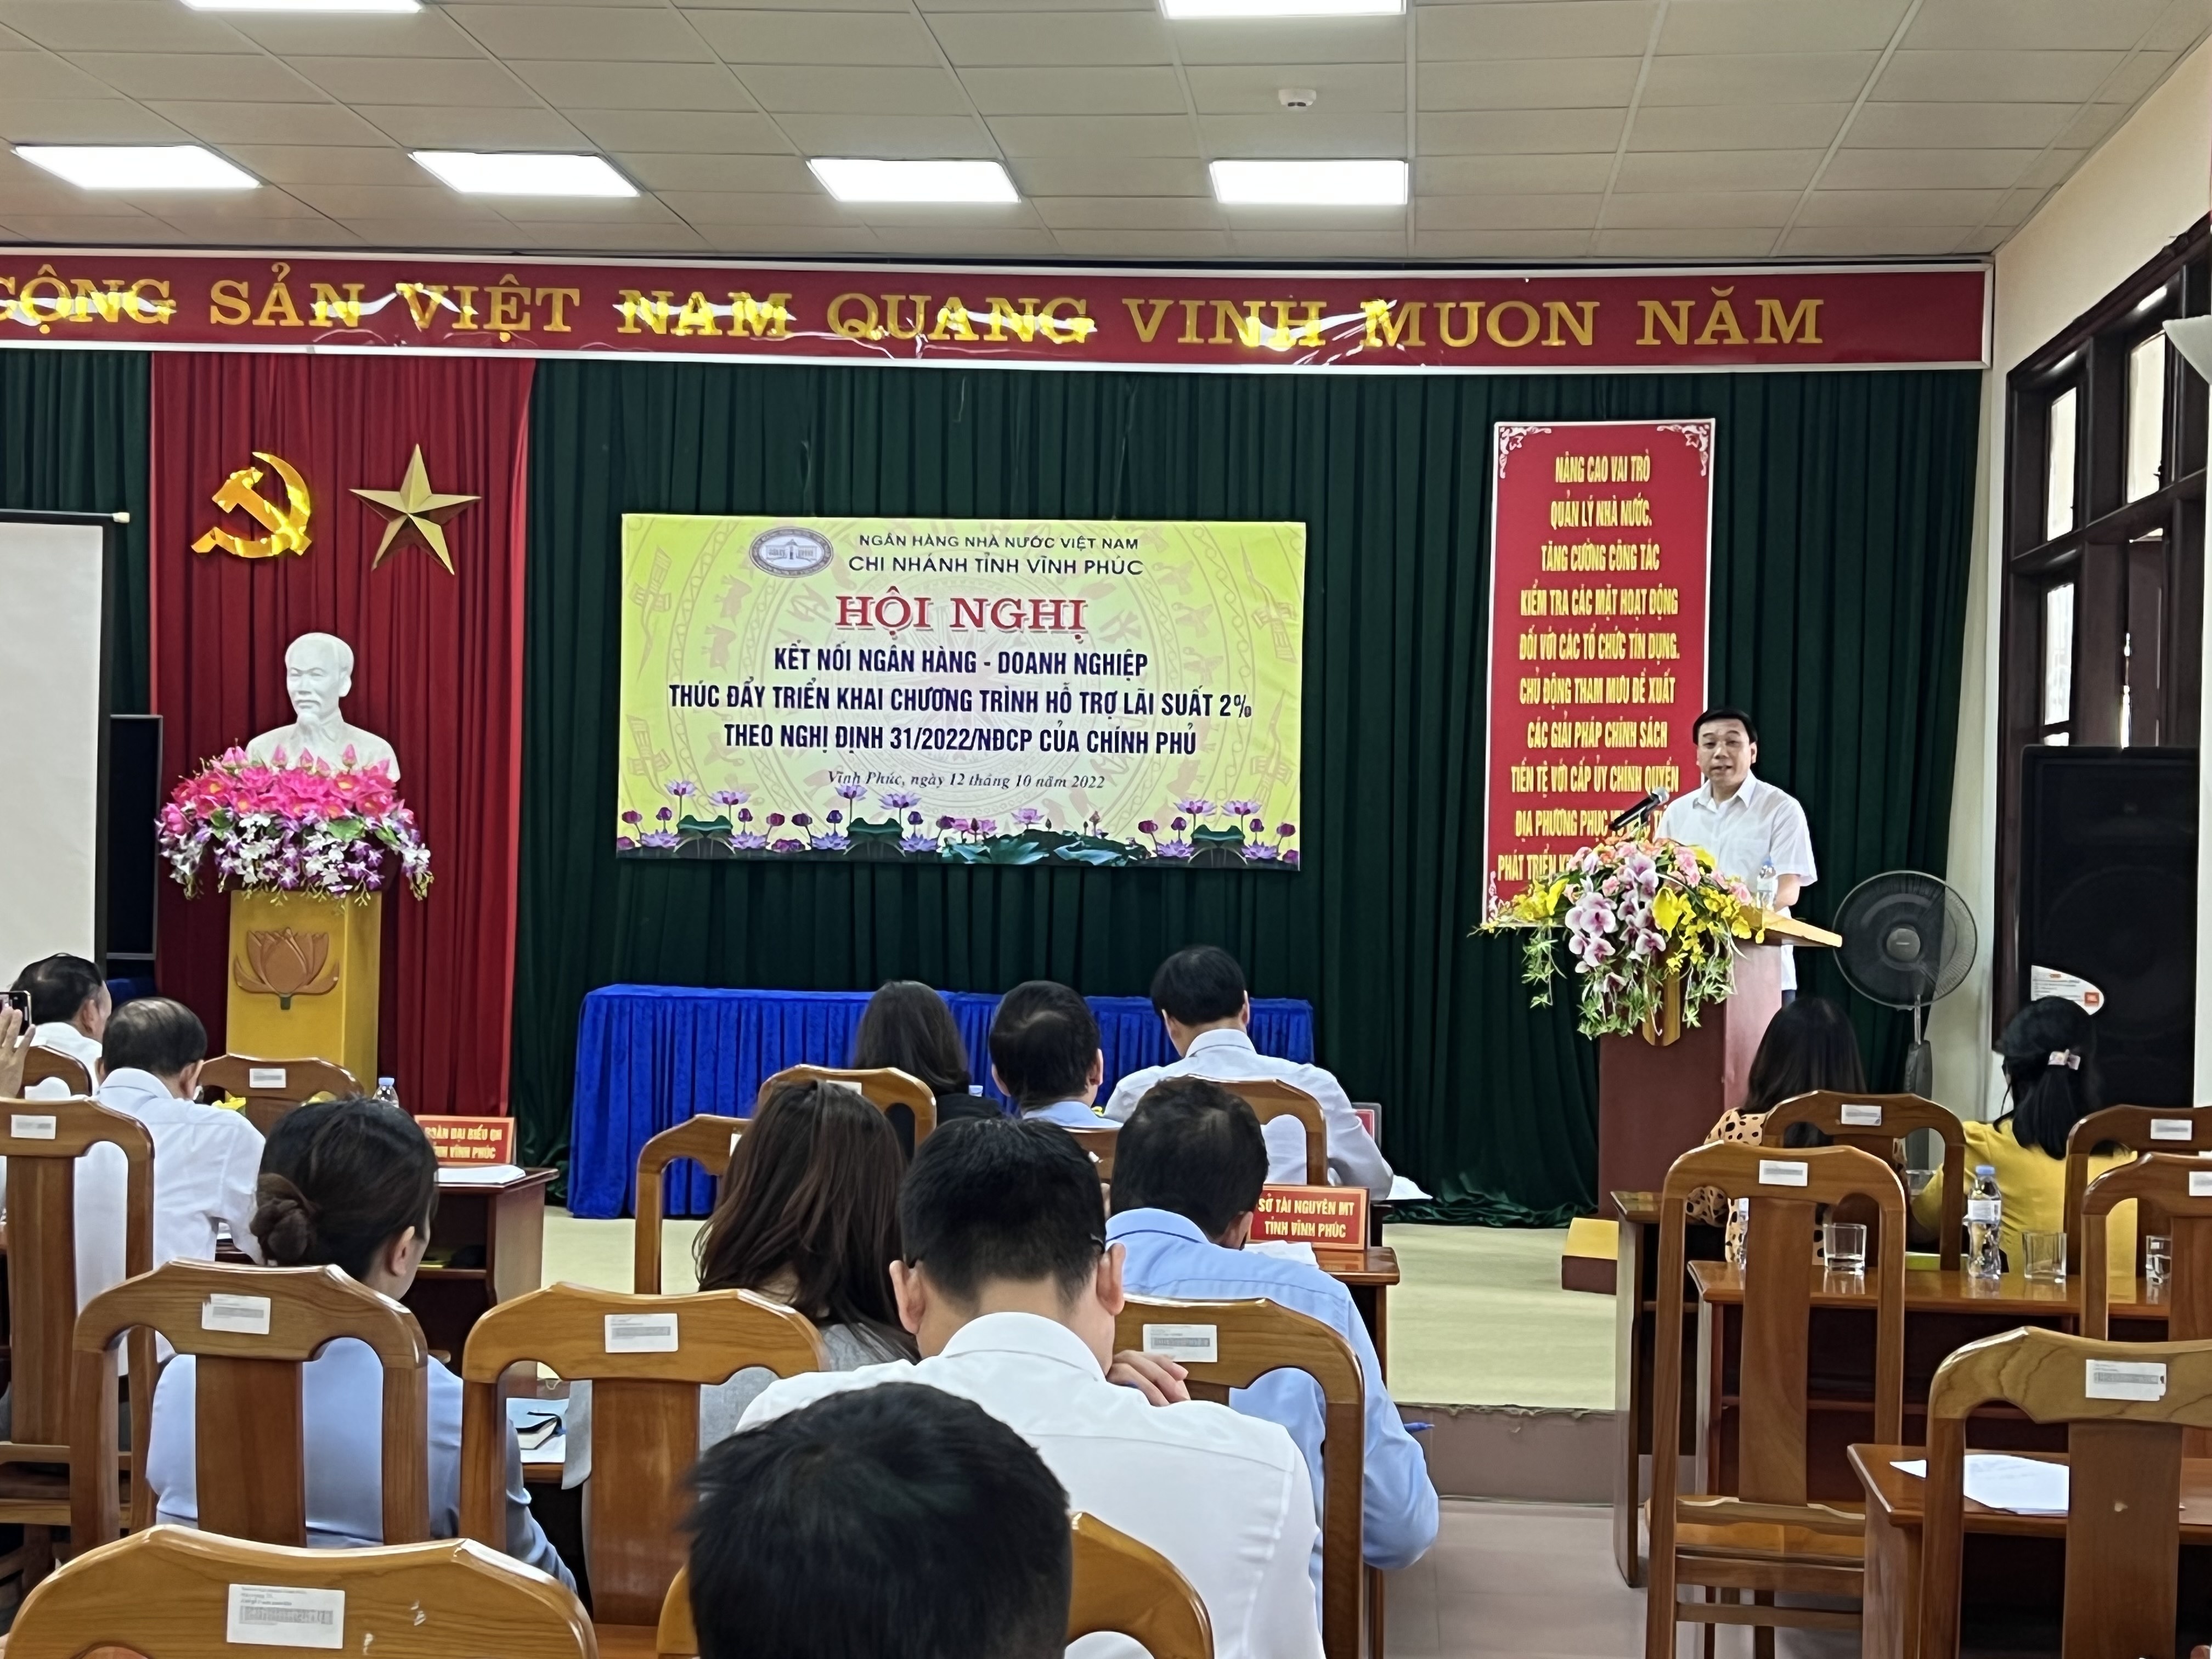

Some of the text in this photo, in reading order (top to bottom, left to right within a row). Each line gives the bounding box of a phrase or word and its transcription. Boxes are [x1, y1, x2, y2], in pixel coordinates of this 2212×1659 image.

[210, 262, 365, 328] SẢN
[395, 274, 579, 342] VIỆT
[617, 290, 792, 338] NAM
[827, 293, 1096, 343] QUANG
[1122, 298, 1328, 347] VINH
[1637, 285, 1824, 346] NĂM
[1555, 449, 1650, 483] NÂNG CAO VAI TRÒ
[1550, 489, 1579, 530] QUẢN
[1582, 495, 1594, 527] LÝ
[1596, 495, 1618, 527] NHÀ
[859, 533, 1138, 551] NGÂN HÀNG NHÀ NƯỚC VIỆT NAM
[1541, 537, 1660, 572] TĂNG CƯỜNG CÔNG TÁC
[848, 552, 1144, 575] CHI NHÁNH TỈNH VĨNH PHÚC
[835, 585, 1088, 642] HỘI NGHỊ
[1520, 579, 1678, 621] KIỂM TRA CÁC MẶT HOẠT ĐỘNG
[1519, 624, 1537, 660] ĐỐI
[1540, 625, 1557, 660] VỚI
[1559, 628, 1580, 660] CÁC
[1583, 623, 1595, 660] TỔ
[1598, 625, 1626, 659] CHỨC
[1628, 627, 1646, 659] TÍN
[774, 640, 810, 670] KẾT
[817, 640, 851, 671] NỐI
[859, 645, 915, 673] NGÂN
[922, 646, 977, 674] HÀNG
[997, 651, 1066, 675] DOANH
[1074, 648, 1148, 682] NGHIỆP
[669, 676, 1252, 720] THÚC ĐẨY TRIỂN KHAI CHƯƠNG TRÌNH HỖ TRỢ LÃI SUẤT 2%
[1520, 666, 1541, 704] CHỦ
[1543, 672, 1571, 710] ĐỘNG
[1574, 677, 1604, 704] THAM
[1632, 667, 1645, 704] ĐỀ
[1648, 668, 1675, 704] XUẤT
[724, 720, 1197, 755] THEO NGHỊ ĐỊNH 31/2022/NĐCP CỦA CHÍNH PHỦ
[1527, 710, 1668, 748] CÁC GIẢI PHÁP CHÍNH SÁCH
[827, 771, 1107, 789] Vĩnh Phúc, ngày 12 tháng 10 năm 2022
[1536, 760, 1548, 798] TỆ
[1551, 758, 1568, 792] VỚI
[1570, 756, 1592, 792] CẤP
[1594, 754, 1608, 792] ỦY
[1610, 759, 1642, 792] CHÍNH
[1515, 810, 1533, 842] ĐỊA
[1536, 808, 1578, 837] PHƯƠNG
[1579, 810, 1608, 842] PHỤC
[1497, 849, 1524, 881] PHÁT
[1526, 843, 1556, 880] TRIỂN
[472, 1145, 496, 1159] PHÚC
[1258, 1193, 1355, 1216] SỞ TÀI NGUYÊN MT
[1265, 1216, 1346, 1238] TỈNH VĨNH PHÚC
